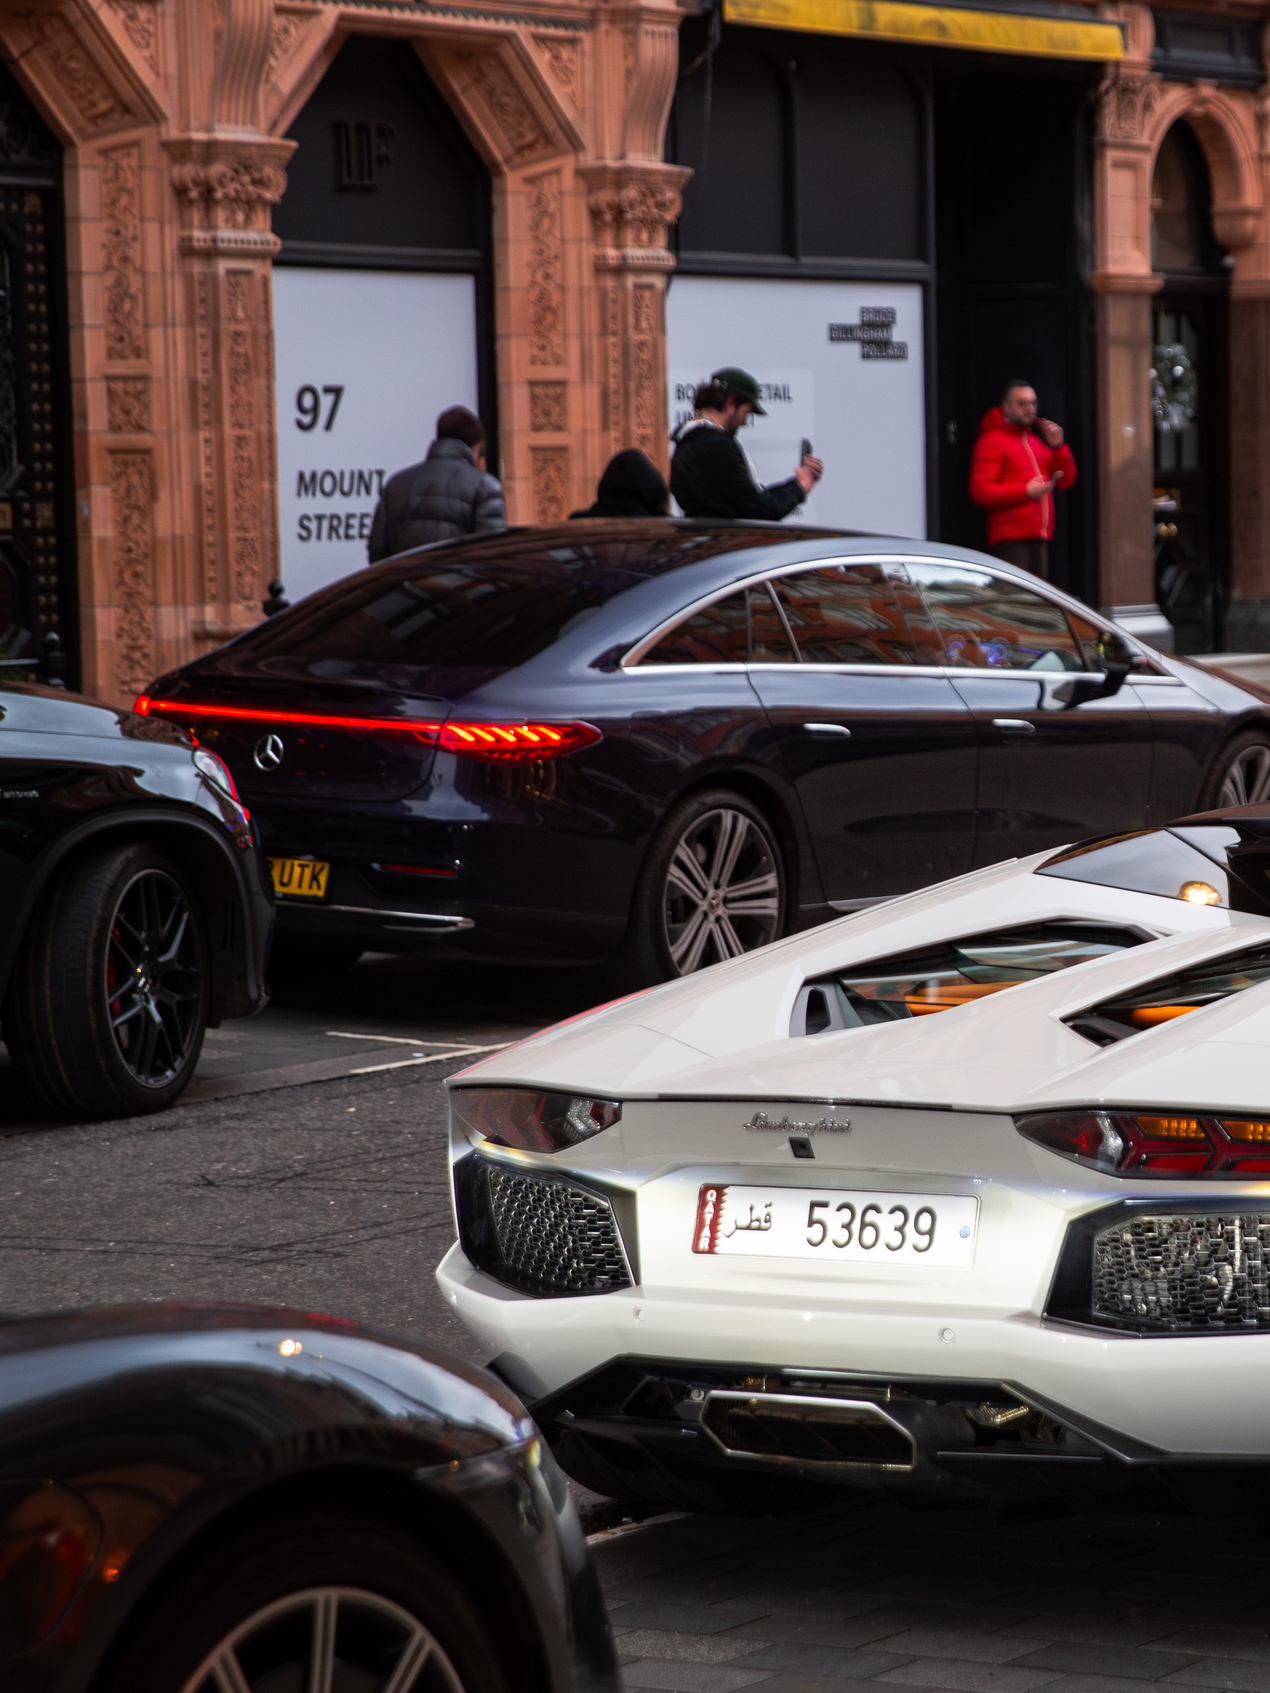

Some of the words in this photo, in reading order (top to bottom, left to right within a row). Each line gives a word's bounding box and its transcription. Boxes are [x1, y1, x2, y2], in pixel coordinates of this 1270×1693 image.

[757, 383, 793, 402] ETAIL
[295, 384, 344, 433] 97
[296, 469, 385, 498] MOUNT
[297, 513, 371, 542] STREE
[279, 861, 325, 891] UTK
[742, 1112, 852, 1136] Lamborghini
[699, 1189, 717, 1251] QATAR
[722, 1201, 773, 1238] قطر
[806, 1200, 938, 1253] 53639
